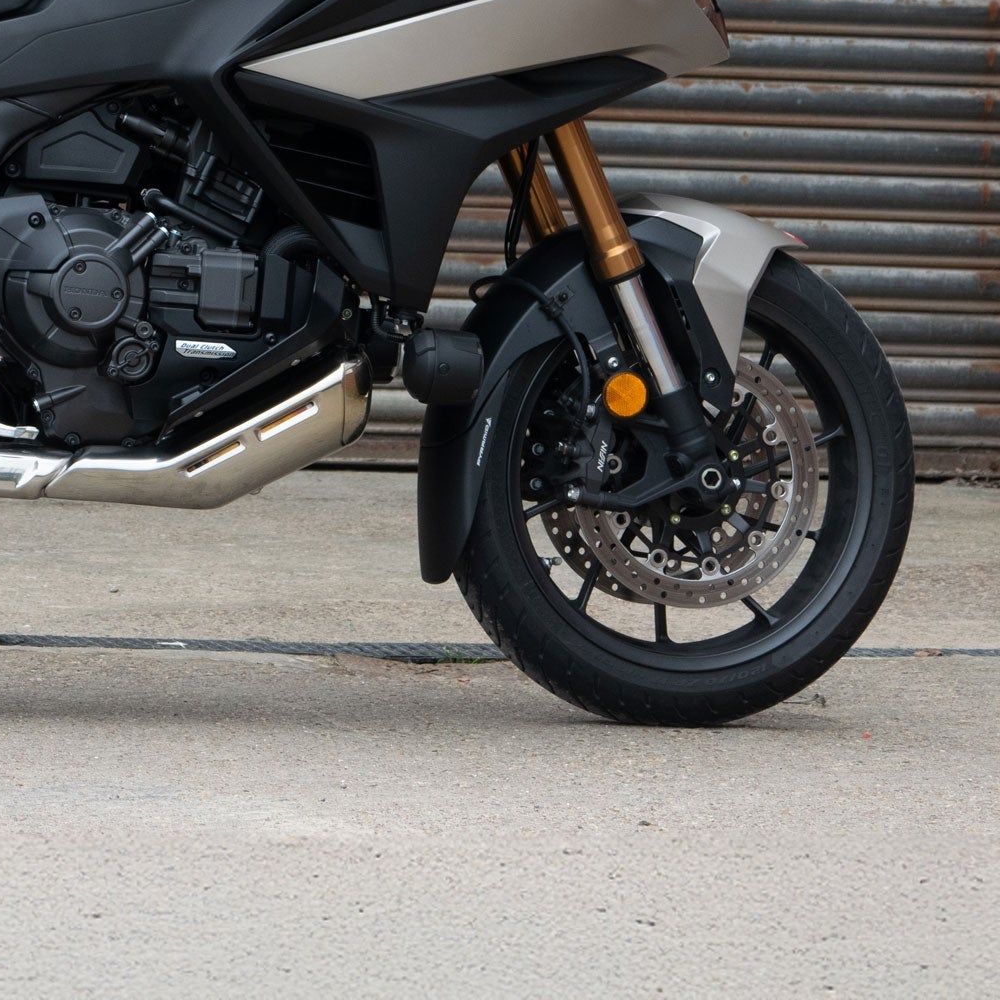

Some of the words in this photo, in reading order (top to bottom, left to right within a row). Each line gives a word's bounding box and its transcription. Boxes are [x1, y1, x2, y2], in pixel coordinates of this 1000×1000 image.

[63, 285, 108, 298] HONDA
[180, 342, 199, 350] Dual
[200, 343, 225, 351] Clutch
[183, 348, 236, 357] Transmission
